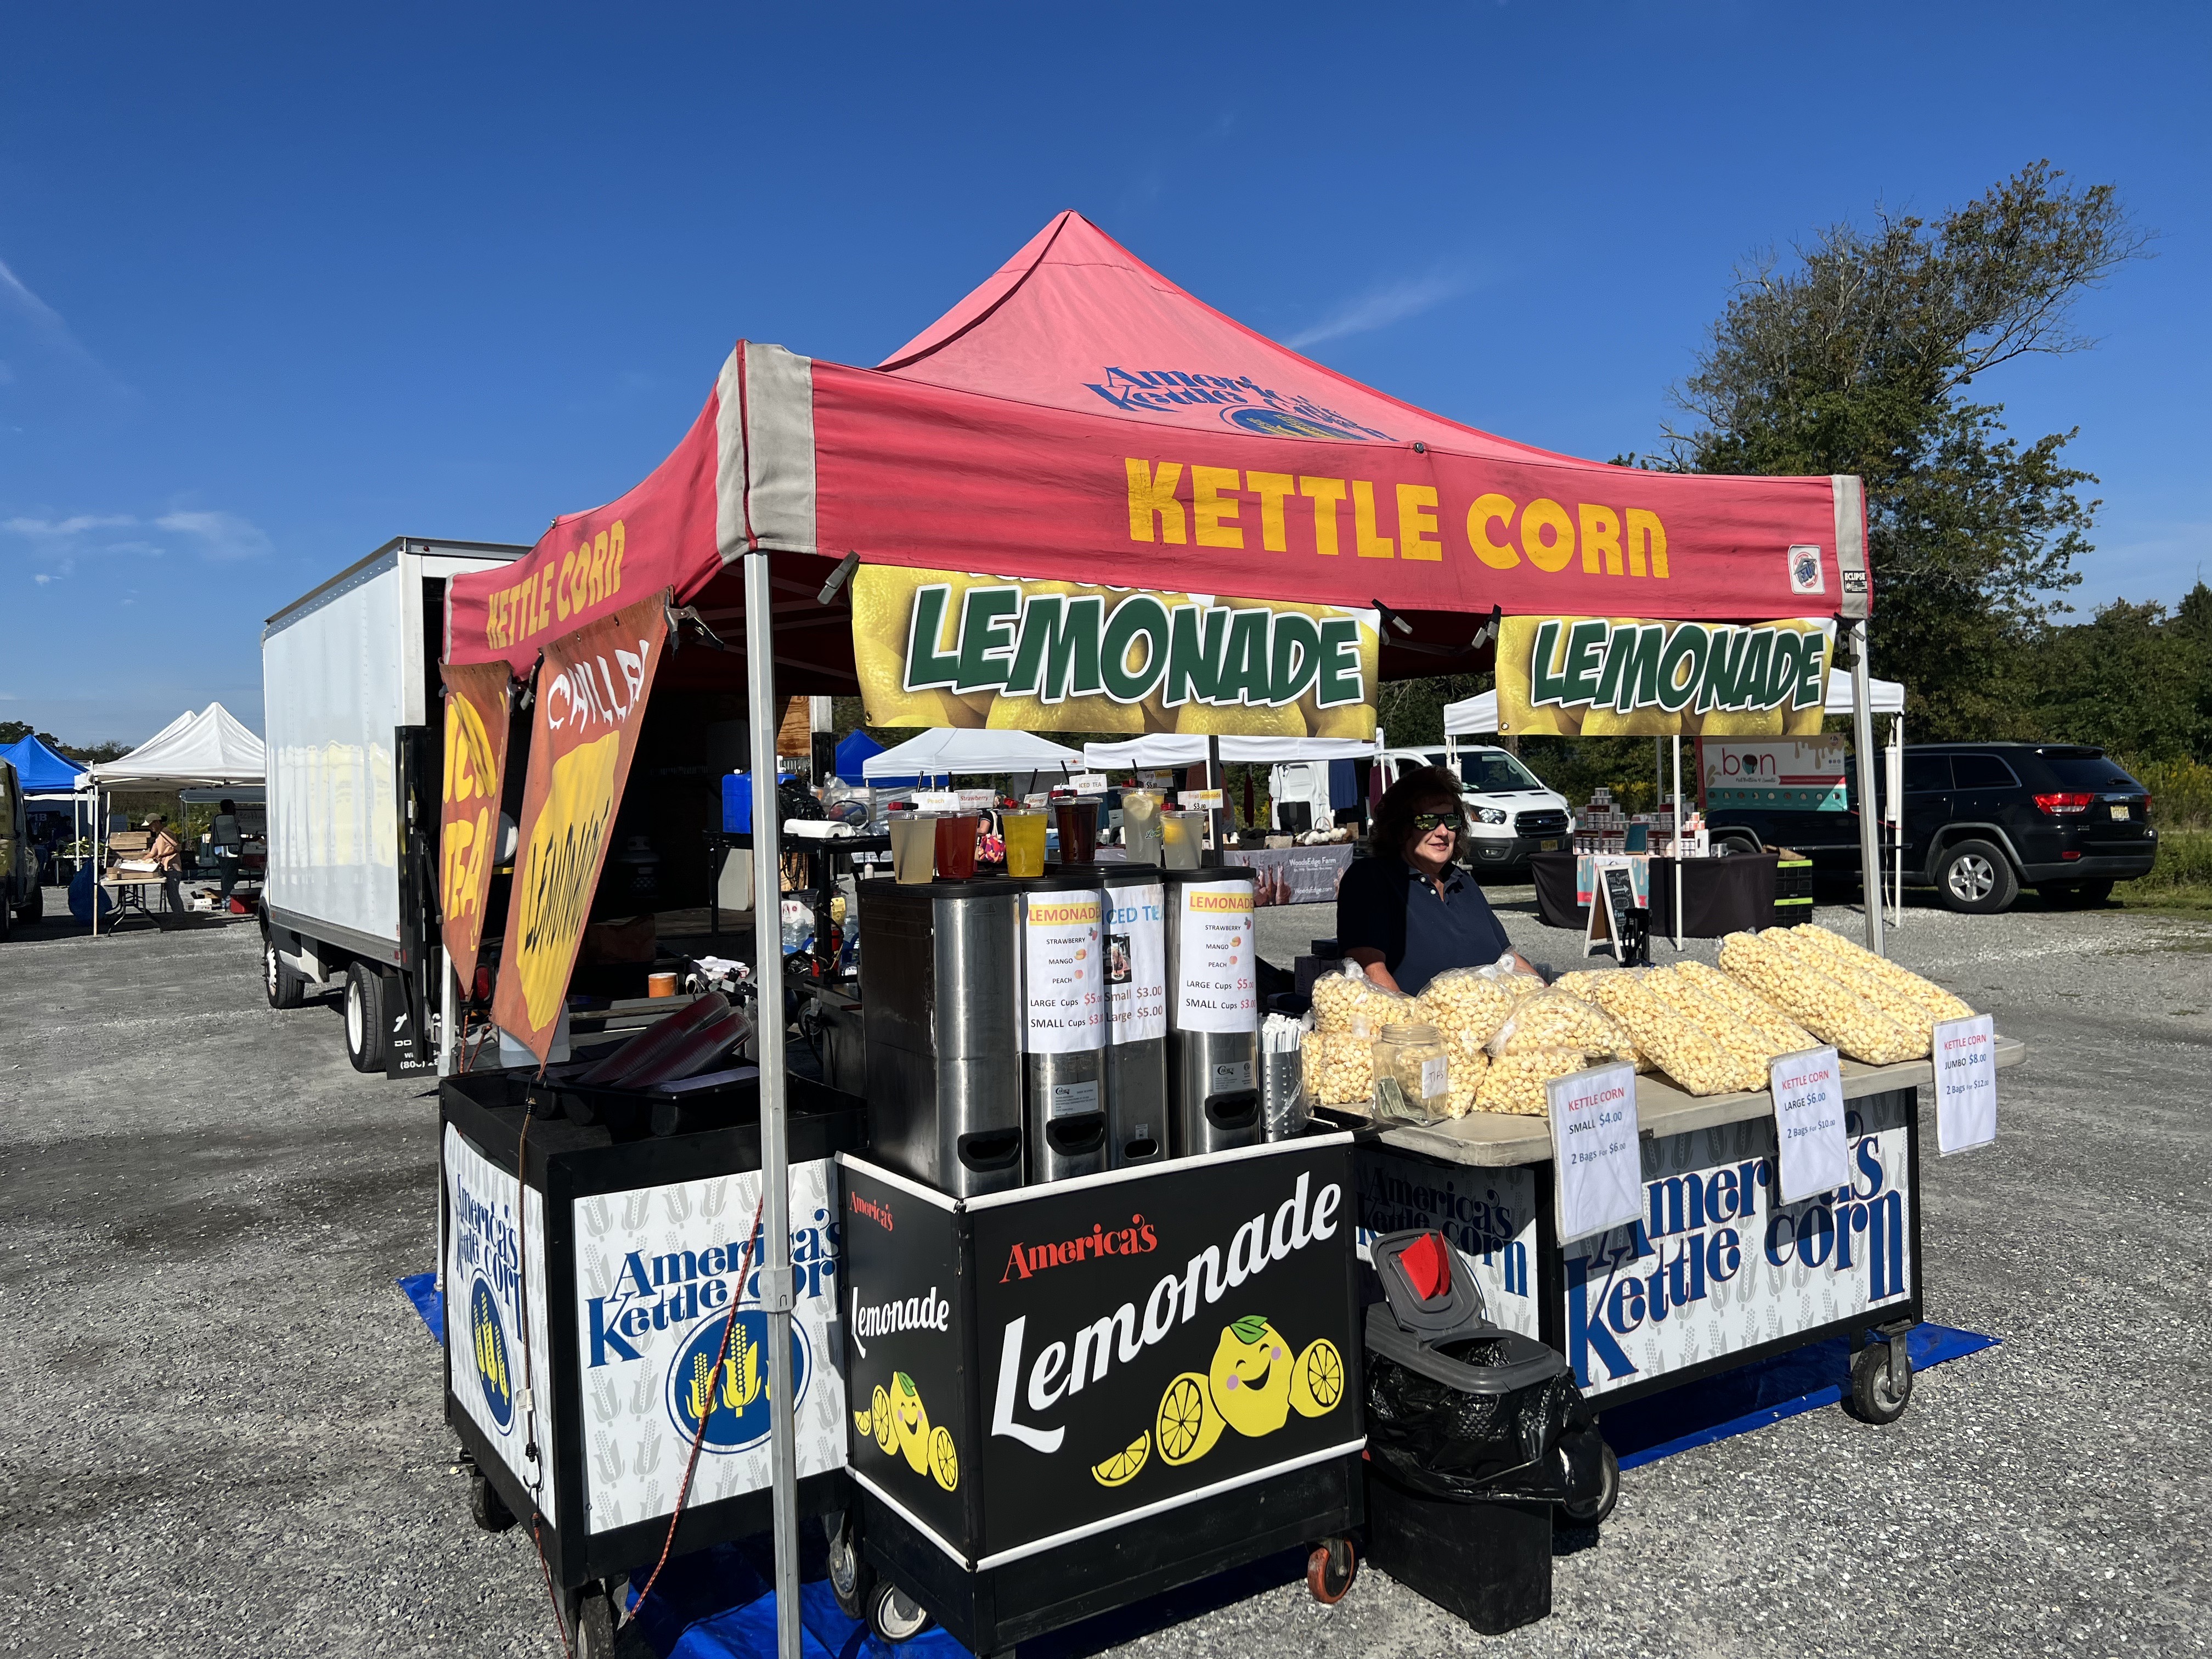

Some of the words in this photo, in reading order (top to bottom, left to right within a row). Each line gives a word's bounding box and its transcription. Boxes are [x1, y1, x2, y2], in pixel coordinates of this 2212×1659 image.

[1125, 456, 1442, 561] KETTLE
[1467, 493, 1669, 579] CORN
[486, 561, 555, 650] KETTLE
[556, 519, 625, 622] CORN
[904, 583, 1364, 709] LEMONADE
[1531, 619, 1826, 715] LEMONADE
[1289, 857, 1321, 867] WoodsEdge
[1190, 896, 1254, 909] LEMONADE
[1029, 906, 1102, 922] LEMONADE
[1105, 989, 1131, 1002] Small
[1136, 985, 1162, 999] $3.00
[1187, 980, 1210, 989] LARGE
[1215, 982, 1232, 990] Cups
[1237, 978, 1254, 990] $5.00
[1060, 999, 1079, 1007] Cups
[1084, 992, 1102, 1006] $5.00
[1186, 998, 1217, 1009] SMALL
[1221, 1002, 1237, 1011] Cups
[1240, 998, 1256, 1011] $3.00
[1031, 1019, 1064, 1028] SMALL
[1068, 1019, 1086, 1028] Cups
[1106, 1012, 1132, 1023] Large
[1137, 1005, 1163, 1019] $5.00
[1944, 1037, 1966, 1051] KETTLE
[1967, 1034, 1987, 1046] CORN
[1945, 1058, 1966, 1070] JUMBO
[1969, 1053, 1987, 1066] $8.00
[1429, 1071, 1444, 1083] TIPS
[1782, 1076, 1807, 1091] KETTLE
[1808, 1069, 1830, 1084] CORN
[1946, 1085, 1951, 1096] 2
[1952, 1084, 1965, 1094] Bags
[1974, 1080, 1989, 1090] $12.00
[1568, 1096, 1599, 1112] KETTLE
[1600, 1086, 1624, 1103] CORN
[1784, 1098, 1805, 1111] LARGE
[1807, 1092, 1826, 1107] $6.00
[1569, 1120, 1596, 1135] SMALL
[1599, 1111, 1623, 1128] $4.00
[1787, 1128, 1792, 1139] 2
[1793, 1126, 1808, 1137] Bags
[1818, 1119, 1836, 1131] $10.00
[1571, 1153, 1577, 1165] 2
[1579, 1150, 1597, 1163] Bags
[1609, 1142, 1626, 1155] $6.00
[849, 1190, 894, 1233] America's
[1368, 1166, 1513, 1240] America's
[458, 1173, 518, 1271] America's
[998, 1213, 1158, 1284] America's
[484, 1244, 524, 1344] corn
[1565, 1228, 1741, 1389] Kettle
[1764, 1189, 1905, 1304] corn
[585, 1275, 728, 1369] Kettle
[851, 1286, 950, 1359] Lemonade
[991, 1171, 1342, 1454] Lemonade
